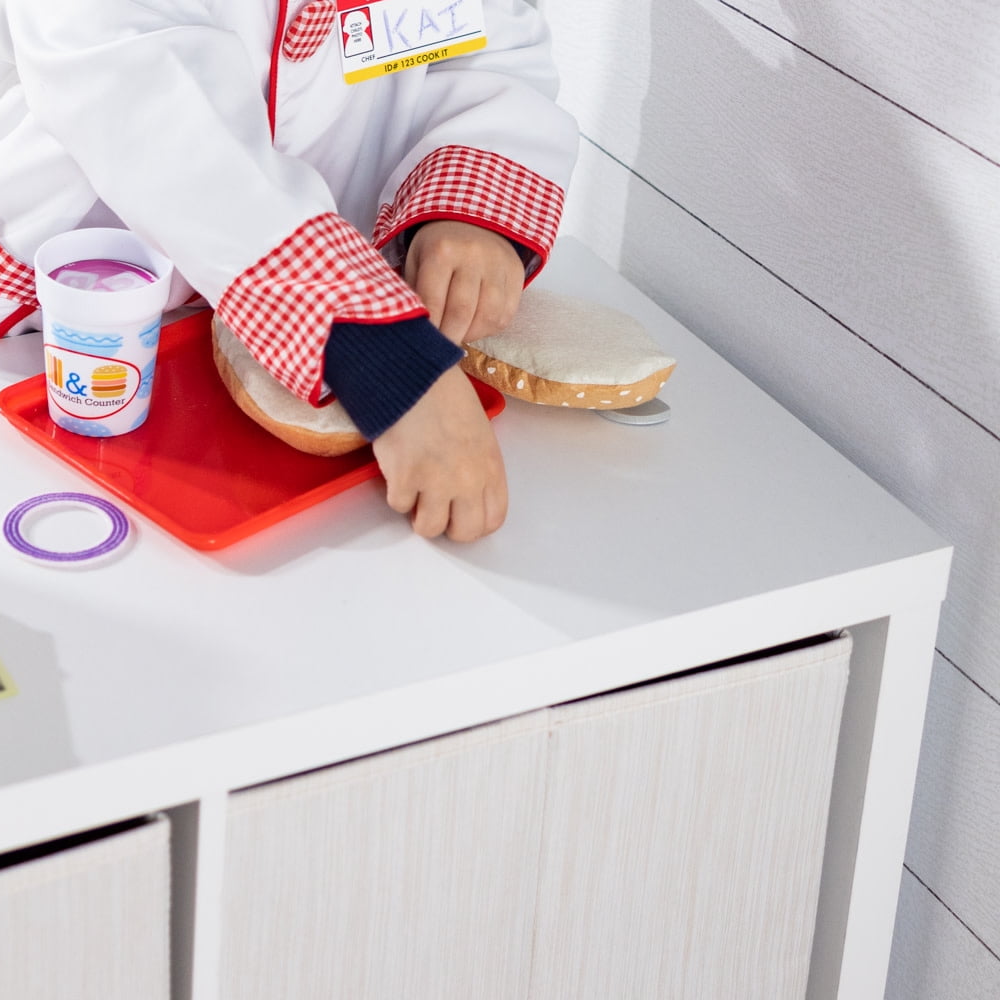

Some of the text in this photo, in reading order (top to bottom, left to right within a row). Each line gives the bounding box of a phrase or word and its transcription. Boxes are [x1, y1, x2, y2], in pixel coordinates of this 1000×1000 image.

[361, 54, 375, 63] CHEF
[384, 48, 448, 72] ID# 123 COOK IT
[48, 384, 126, 407] andwich Counter
